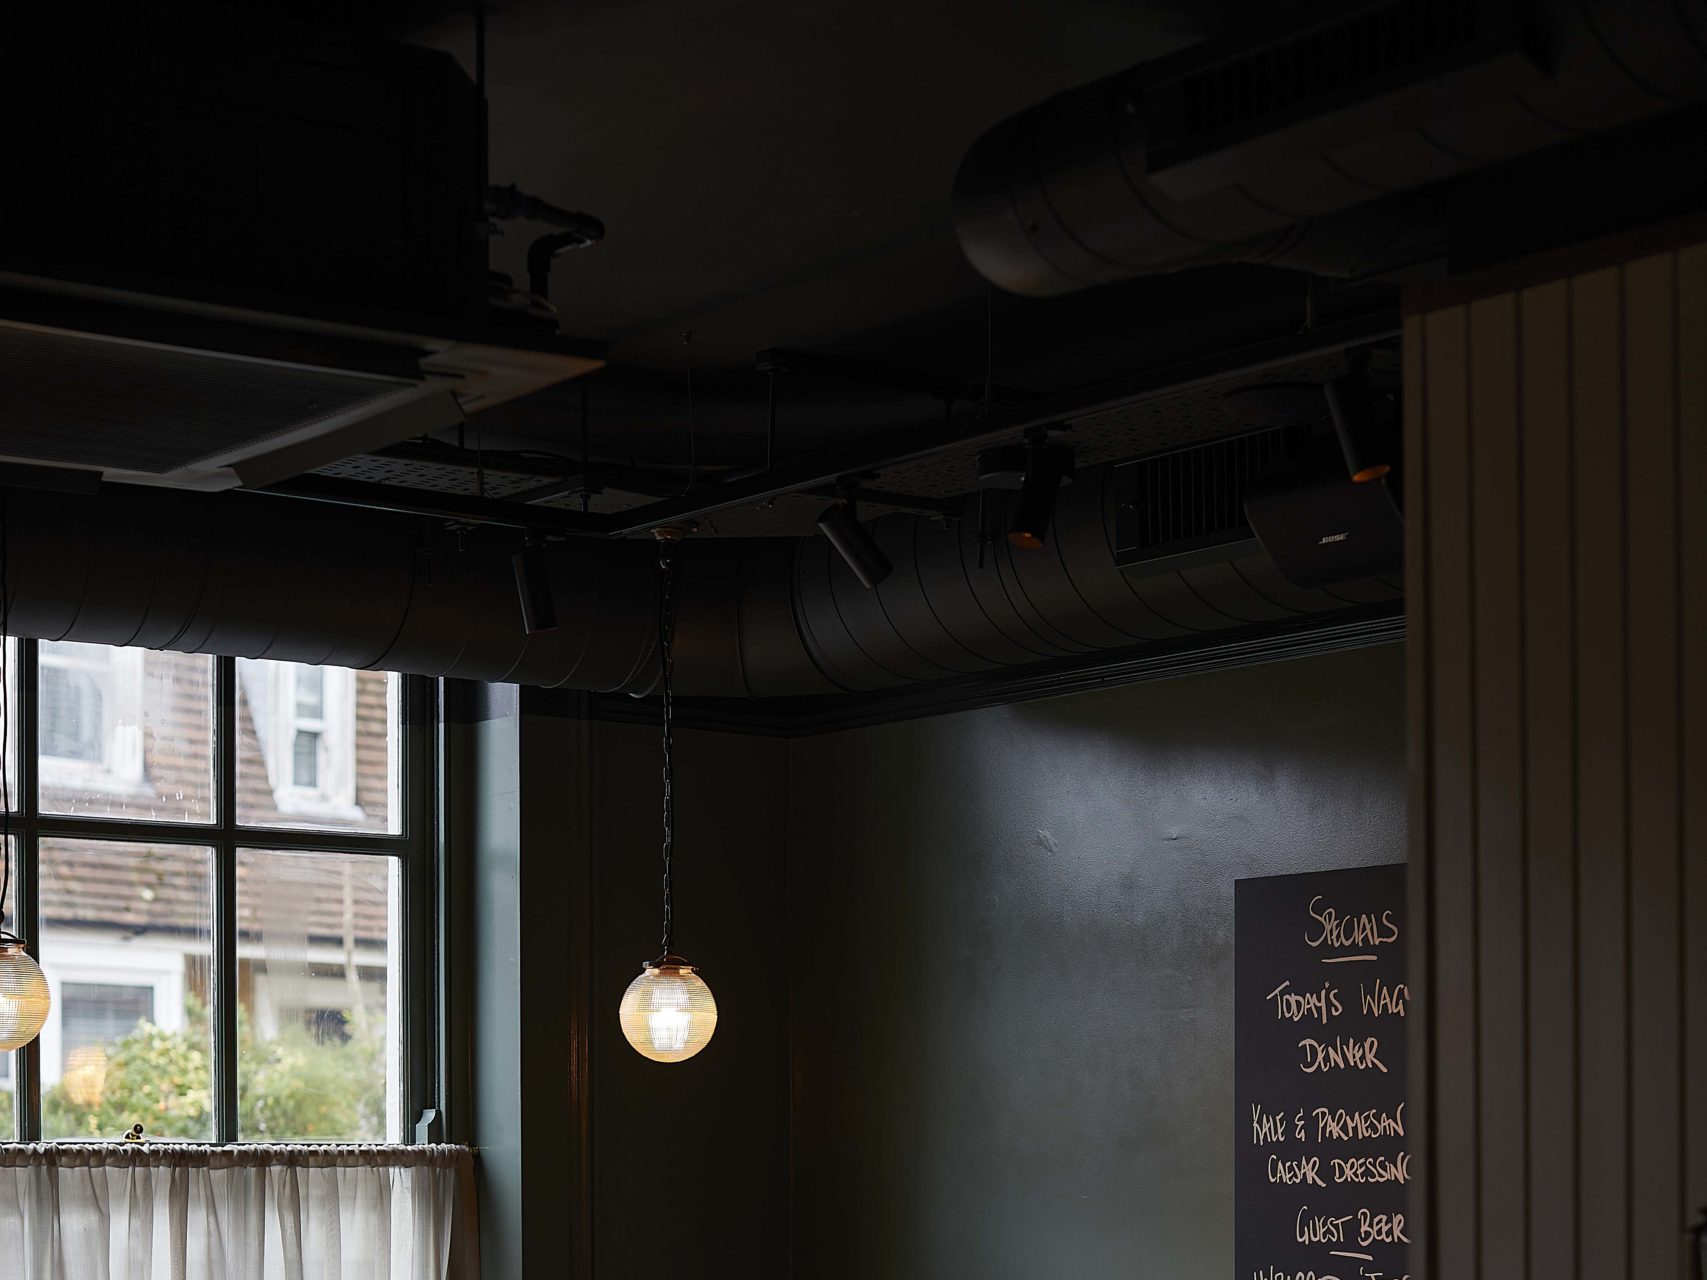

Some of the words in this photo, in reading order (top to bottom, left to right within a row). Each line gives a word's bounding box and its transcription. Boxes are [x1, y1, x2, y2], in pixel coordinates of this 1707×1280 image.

[1318, 532, 1349, 544] BOSE
[1266, 980, 1342, 1024] TODAY'S
[1298, 1036, 1387, 1073] DENVER
[1252, 1102, 1285, 1145] KALE
[1313, 1102, 1404, 1143] PARMESAN
[1268, 1154, 1326, 1187] CAESAR
[1296, 1206, 1353, 1245] GUEST
[1358, 1208, 1411, 1246] BEER
